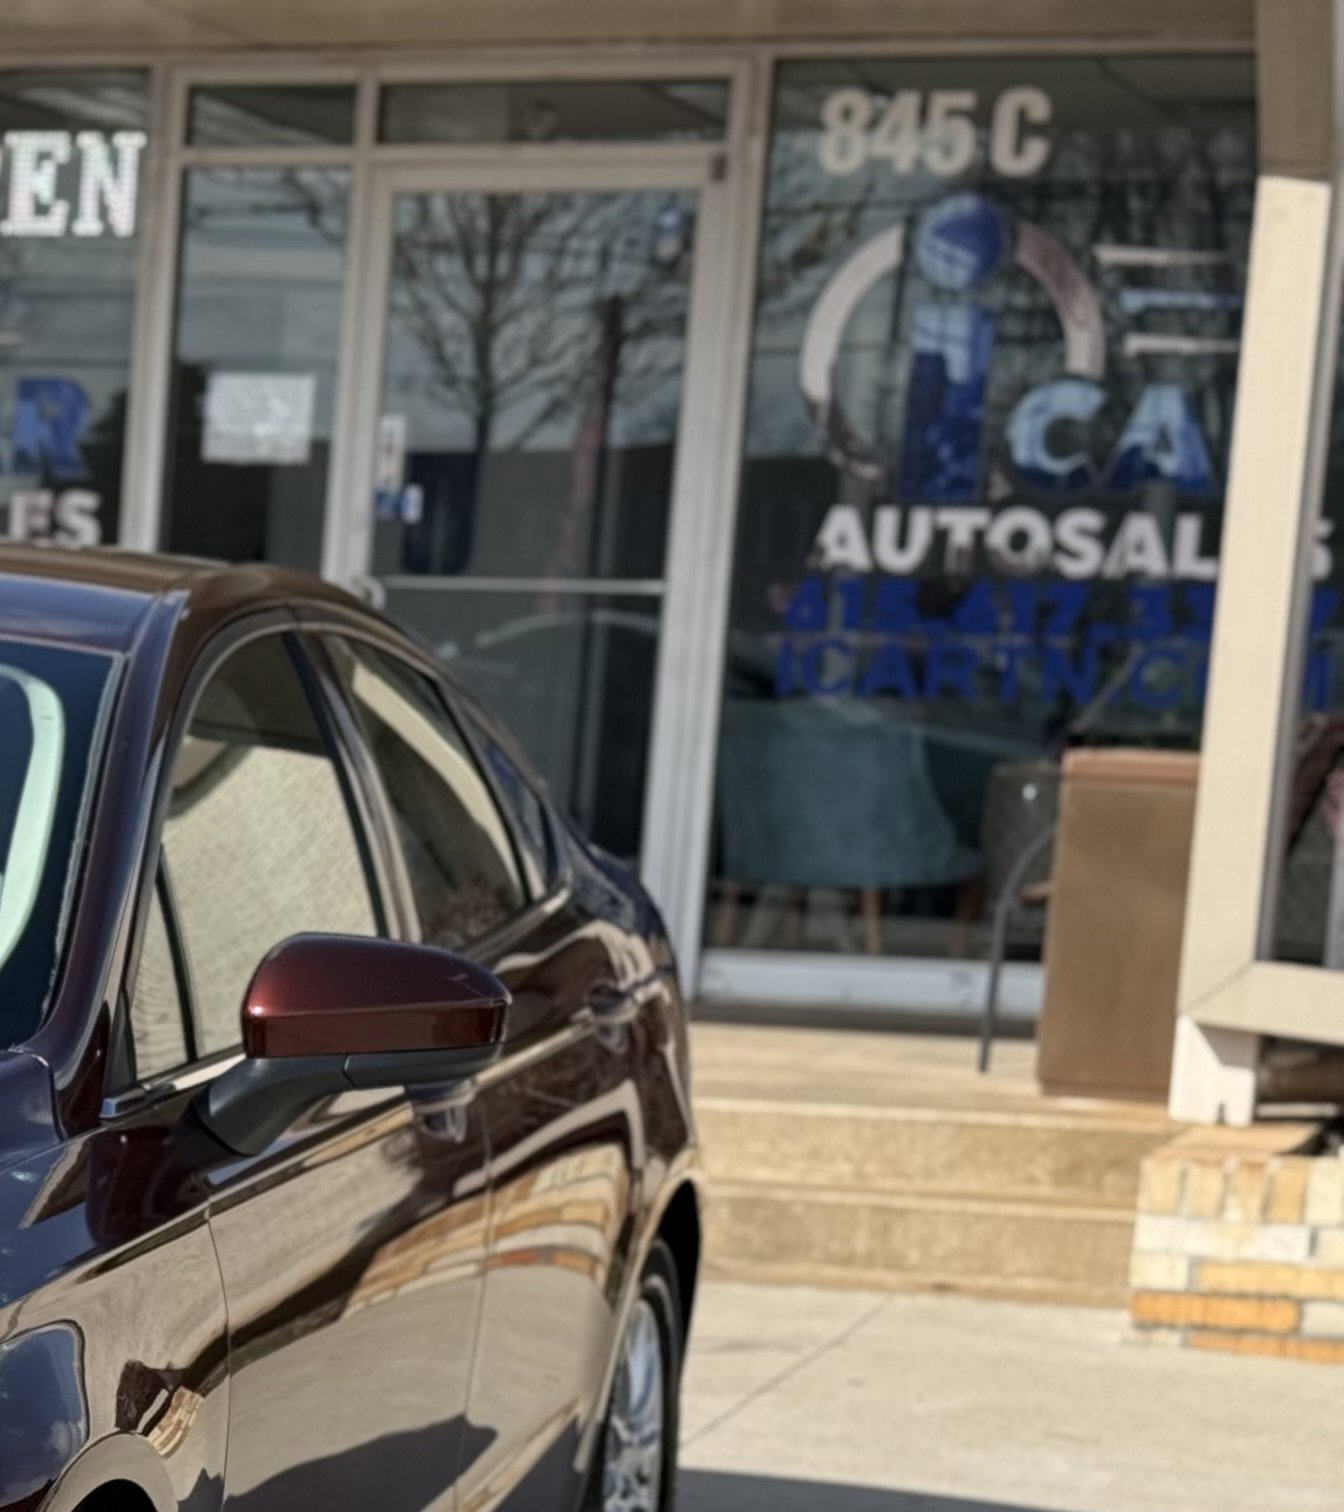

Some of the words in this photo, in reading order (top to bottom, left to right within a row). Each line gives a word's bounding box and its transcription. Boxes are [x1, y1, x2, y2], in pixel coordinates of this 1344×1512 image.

[816, 87, 978, 177] 845
[990, 84, 1053, 177] C
[1005, 378, 1216, 492] CA
[815, 504, 1333, 580] AUTOSAL
[773, 639, 1330, 710] ICARTN.C
